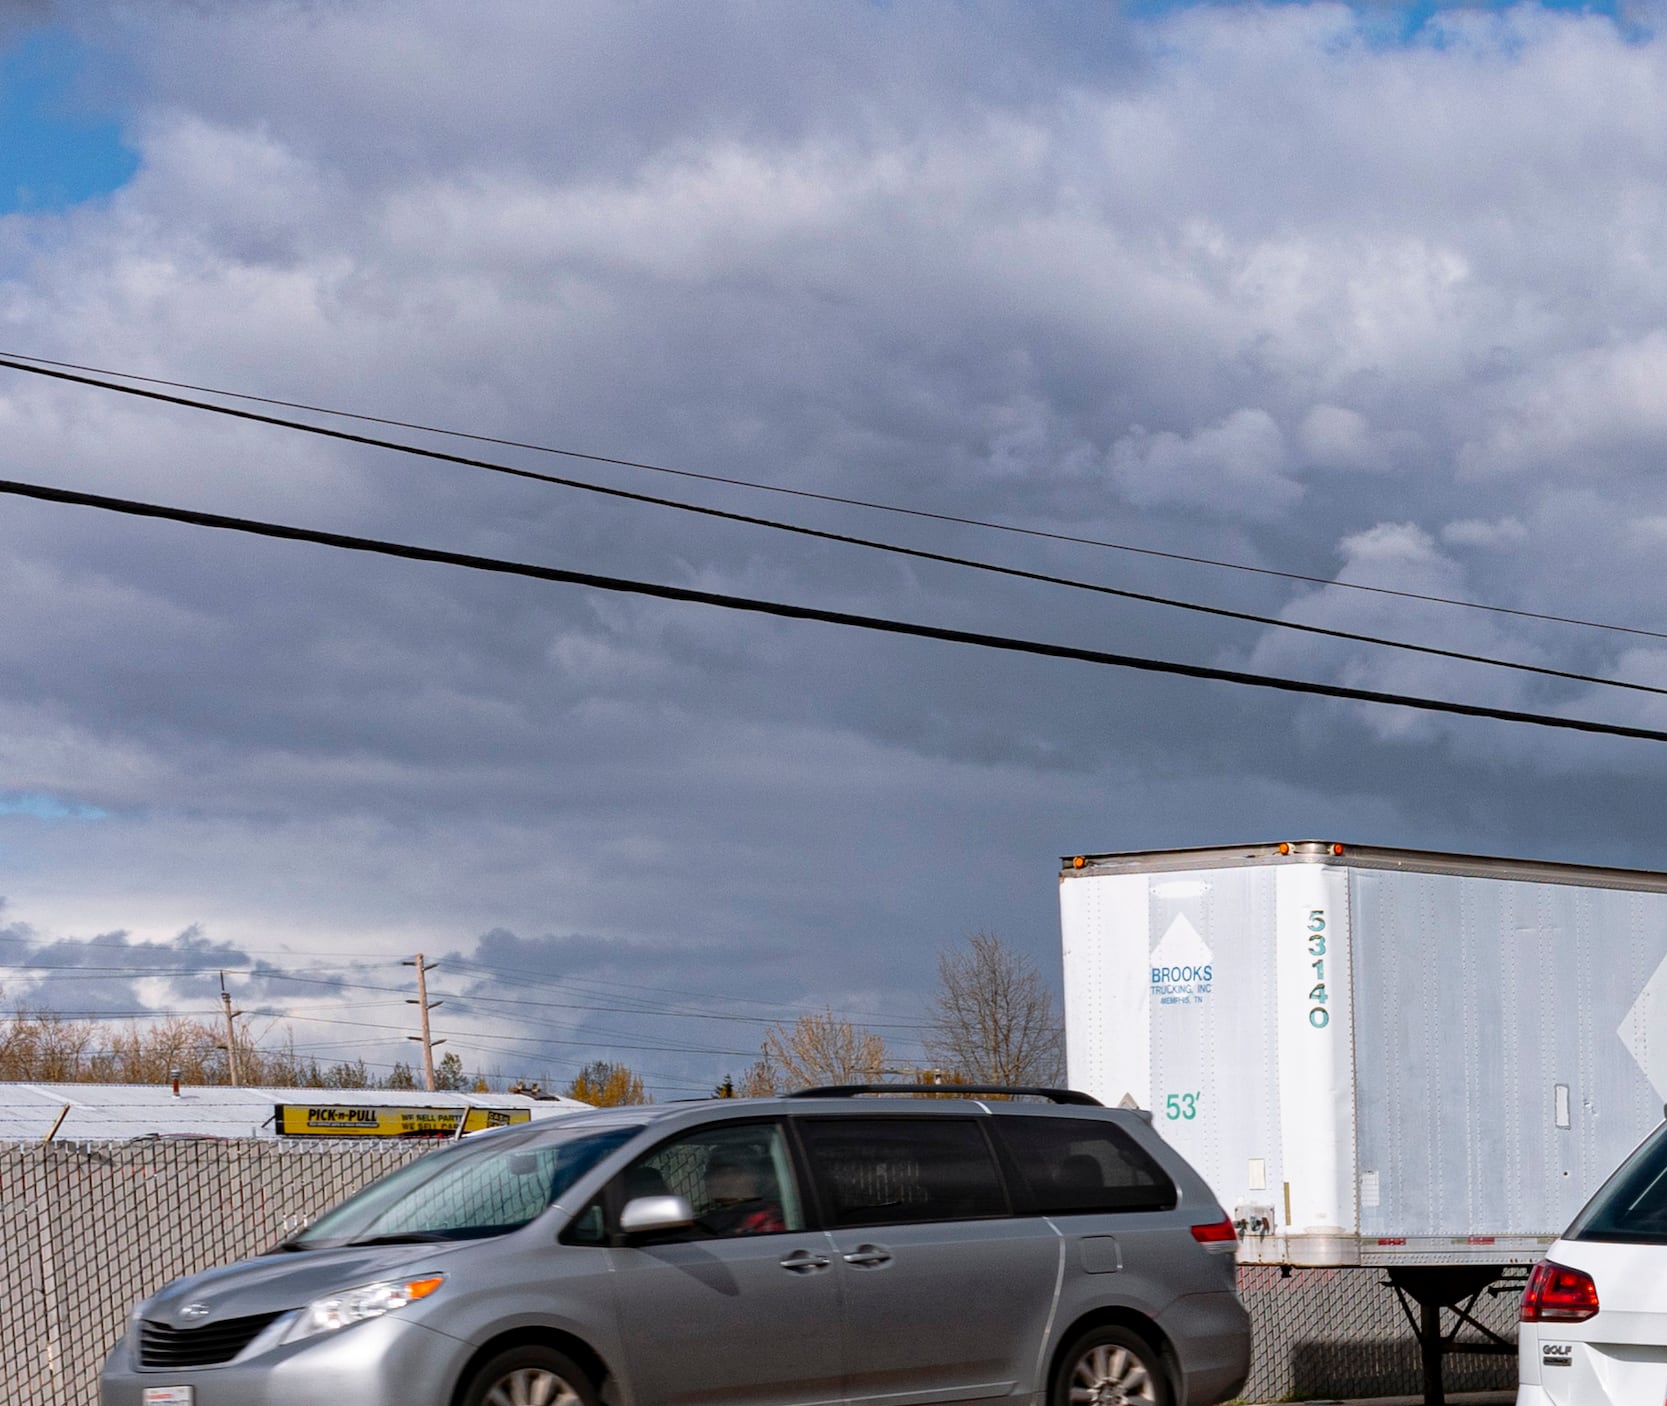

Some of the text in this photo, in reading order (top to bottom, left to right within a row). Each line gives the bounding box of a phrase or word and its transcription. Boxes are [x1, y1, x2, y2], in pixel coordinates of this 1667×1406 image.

[1151, 965, 1213, 983] BROOKS
[1307, 910, 1329, 1028] 53140
[1543, 1345, 1572, 1355] GOLF
